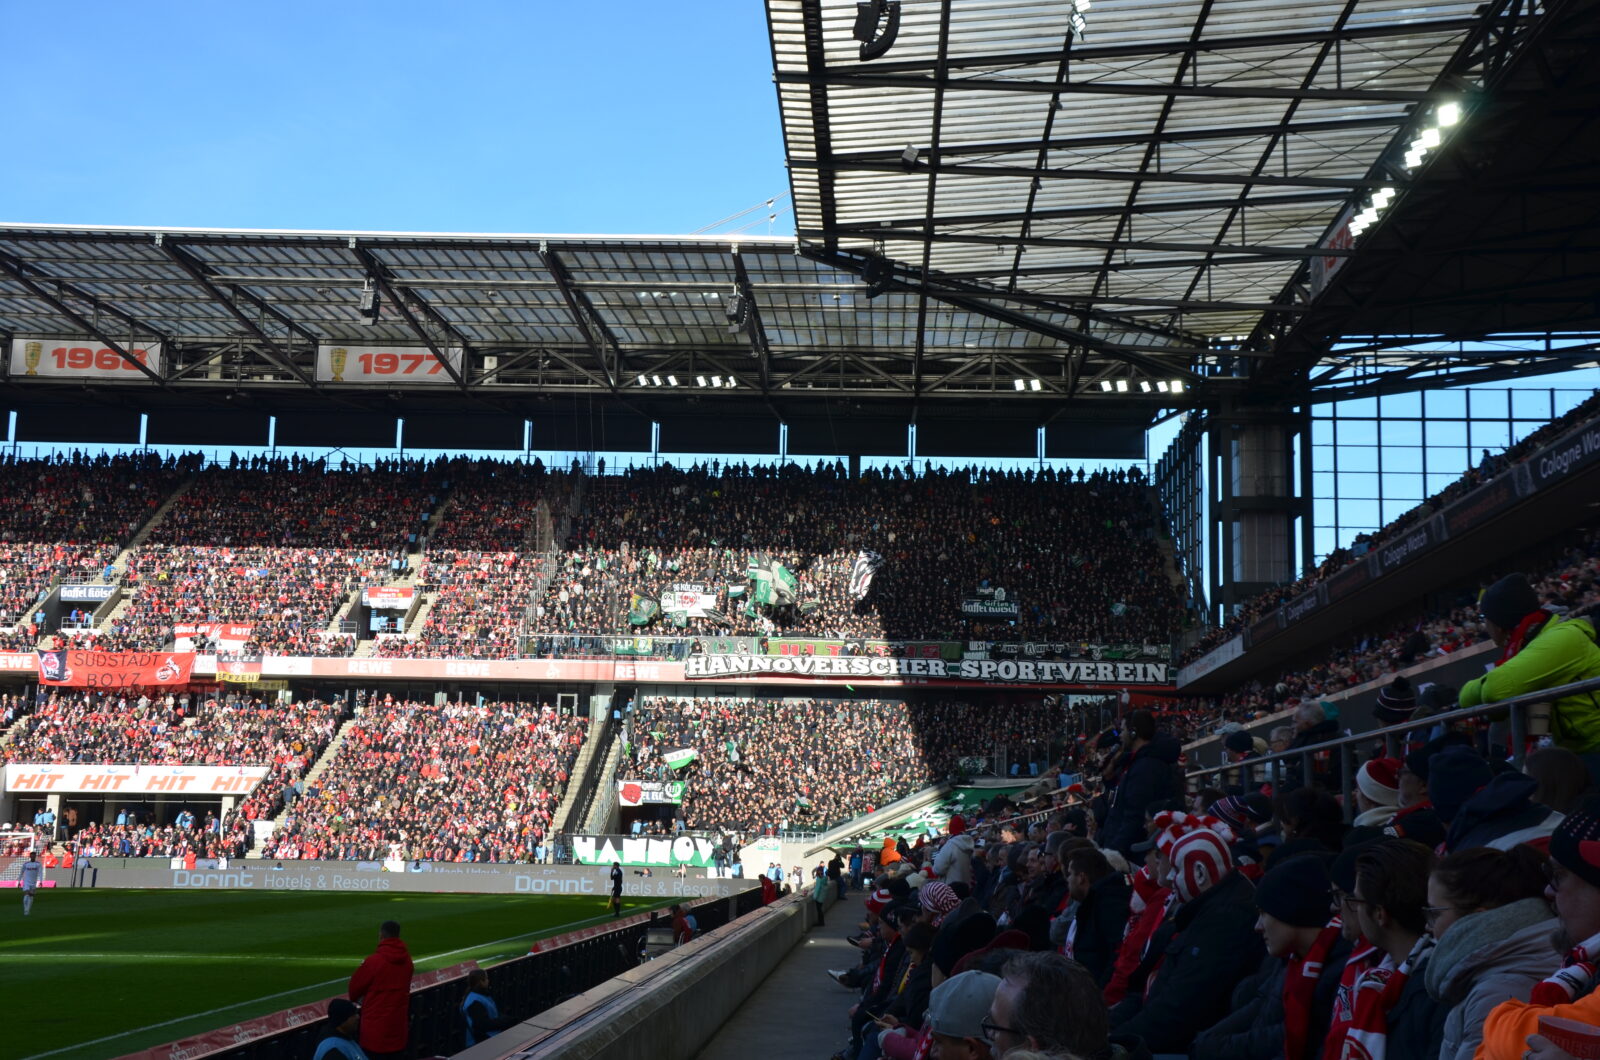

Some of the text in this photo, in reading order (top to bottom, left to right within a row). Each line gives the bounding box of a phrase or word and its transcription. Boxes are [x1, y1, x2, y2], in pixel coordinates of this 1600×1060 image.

[359, 353, 447, 374] 1977
[1540, 445, 1582, 478] Cologne
[1383, 544, 1407, 567] Cologne
[61, 587, 87, 598] Gaffel
[74, 651, 161, 668] SÜDSTADT
[348, 661, 392, 674] REWE
[446, 663, 490, 676] REWE
[615, 665, 660, 679] REWE
[688, 656, 1167, 682] HANNOVERSCHER SPORTVEREIN
[87, 673, 141, 687] BOYZ
[13, 774, 64, 789] HIT
[80, 775, 130, 790] HIT
[145, 776, 196, 791] HIT
[211, 776, 260, 791] HIT
[174, 870, 391, 890] Dorint Hotels & Resorts
[515, 876, 729, 897] Dorint Htels & Resorts
